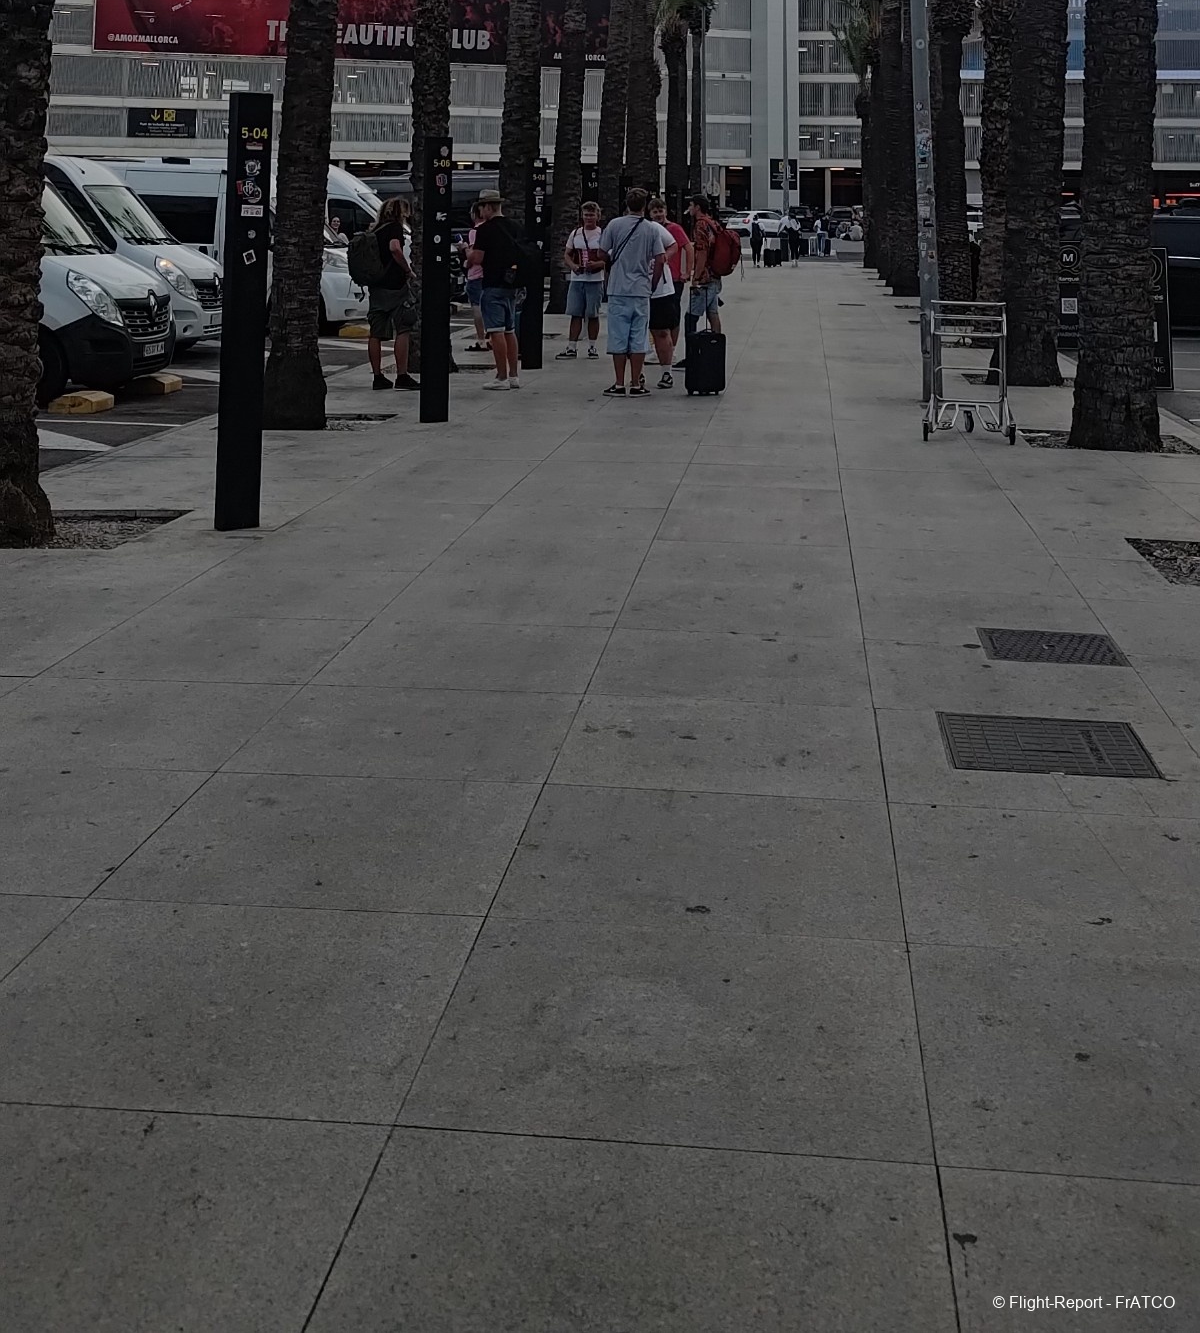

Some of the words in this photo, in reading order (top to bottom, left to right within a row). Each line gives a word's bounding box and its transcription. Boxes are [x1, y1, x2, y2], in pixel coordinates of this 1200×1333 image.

[107, 34, 179, 45] @AMOKMALLORCA
[451, 28, 490, 50] LUB
[241, 126, 269, 140] 5-04
[433, 158, 451, 168] 5-06
[1062, 253, 1074, 262] M
